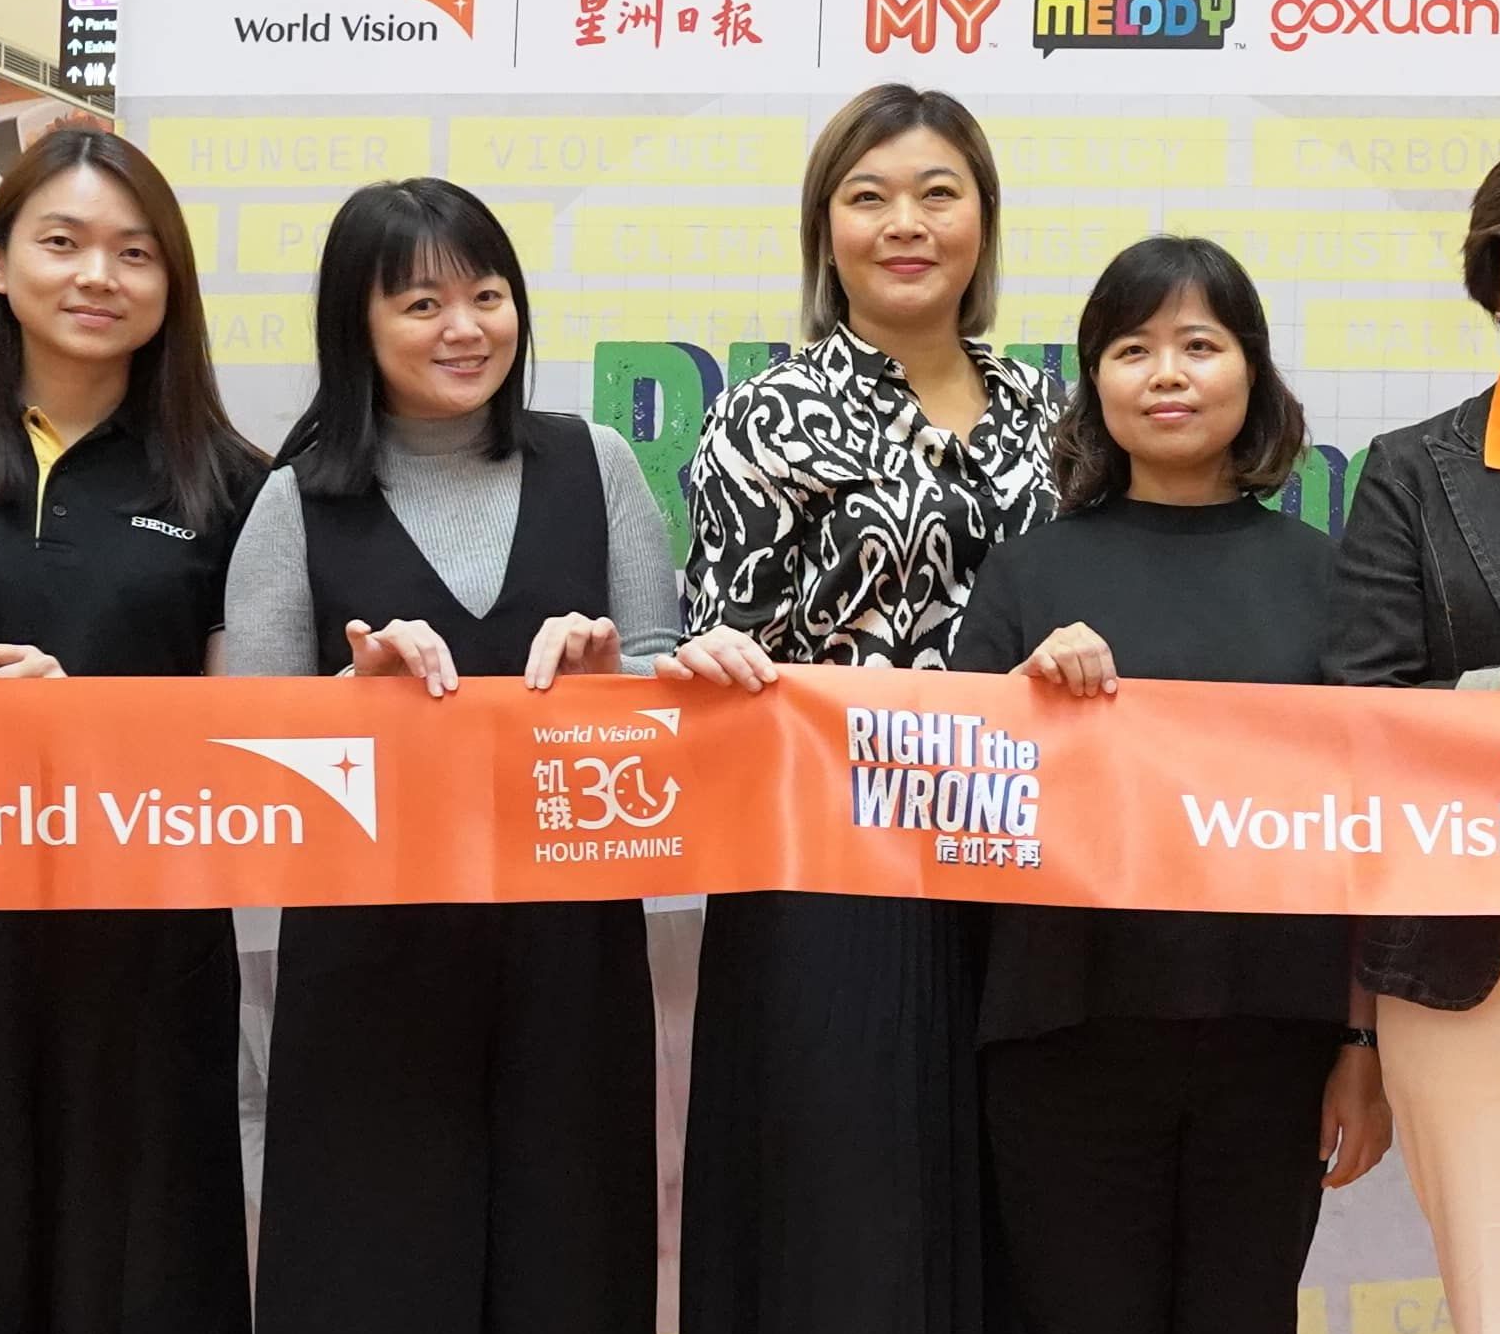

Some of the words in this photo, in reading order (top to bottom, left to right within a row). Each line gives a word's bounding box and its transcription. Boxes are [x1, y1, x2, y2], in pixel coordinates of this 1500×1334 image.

[235, 13, 330, 42] World
[341, 14, 437, 41] Vision
[190, 135, 390, 171] HUNGER
[485, 134, 766, 171] VIOLENCE
[612, 223, 786, 264] CLIMA
[130, 516, 196, 541] SEIKO
[534, 725, 593, 742] World
[598, 726, 656, 742] Vision
[847, 707, 983, 767] RIGHT
[981, 730, 1039, 771] the
[99, 789, 302, 845] Vision
[852, 766, 1040, 835] WRONG
[1182, 795, 1381, 852] World
[536, 842, 598, 861] HOUR
[605, 837, 682, 859] FAMINE
